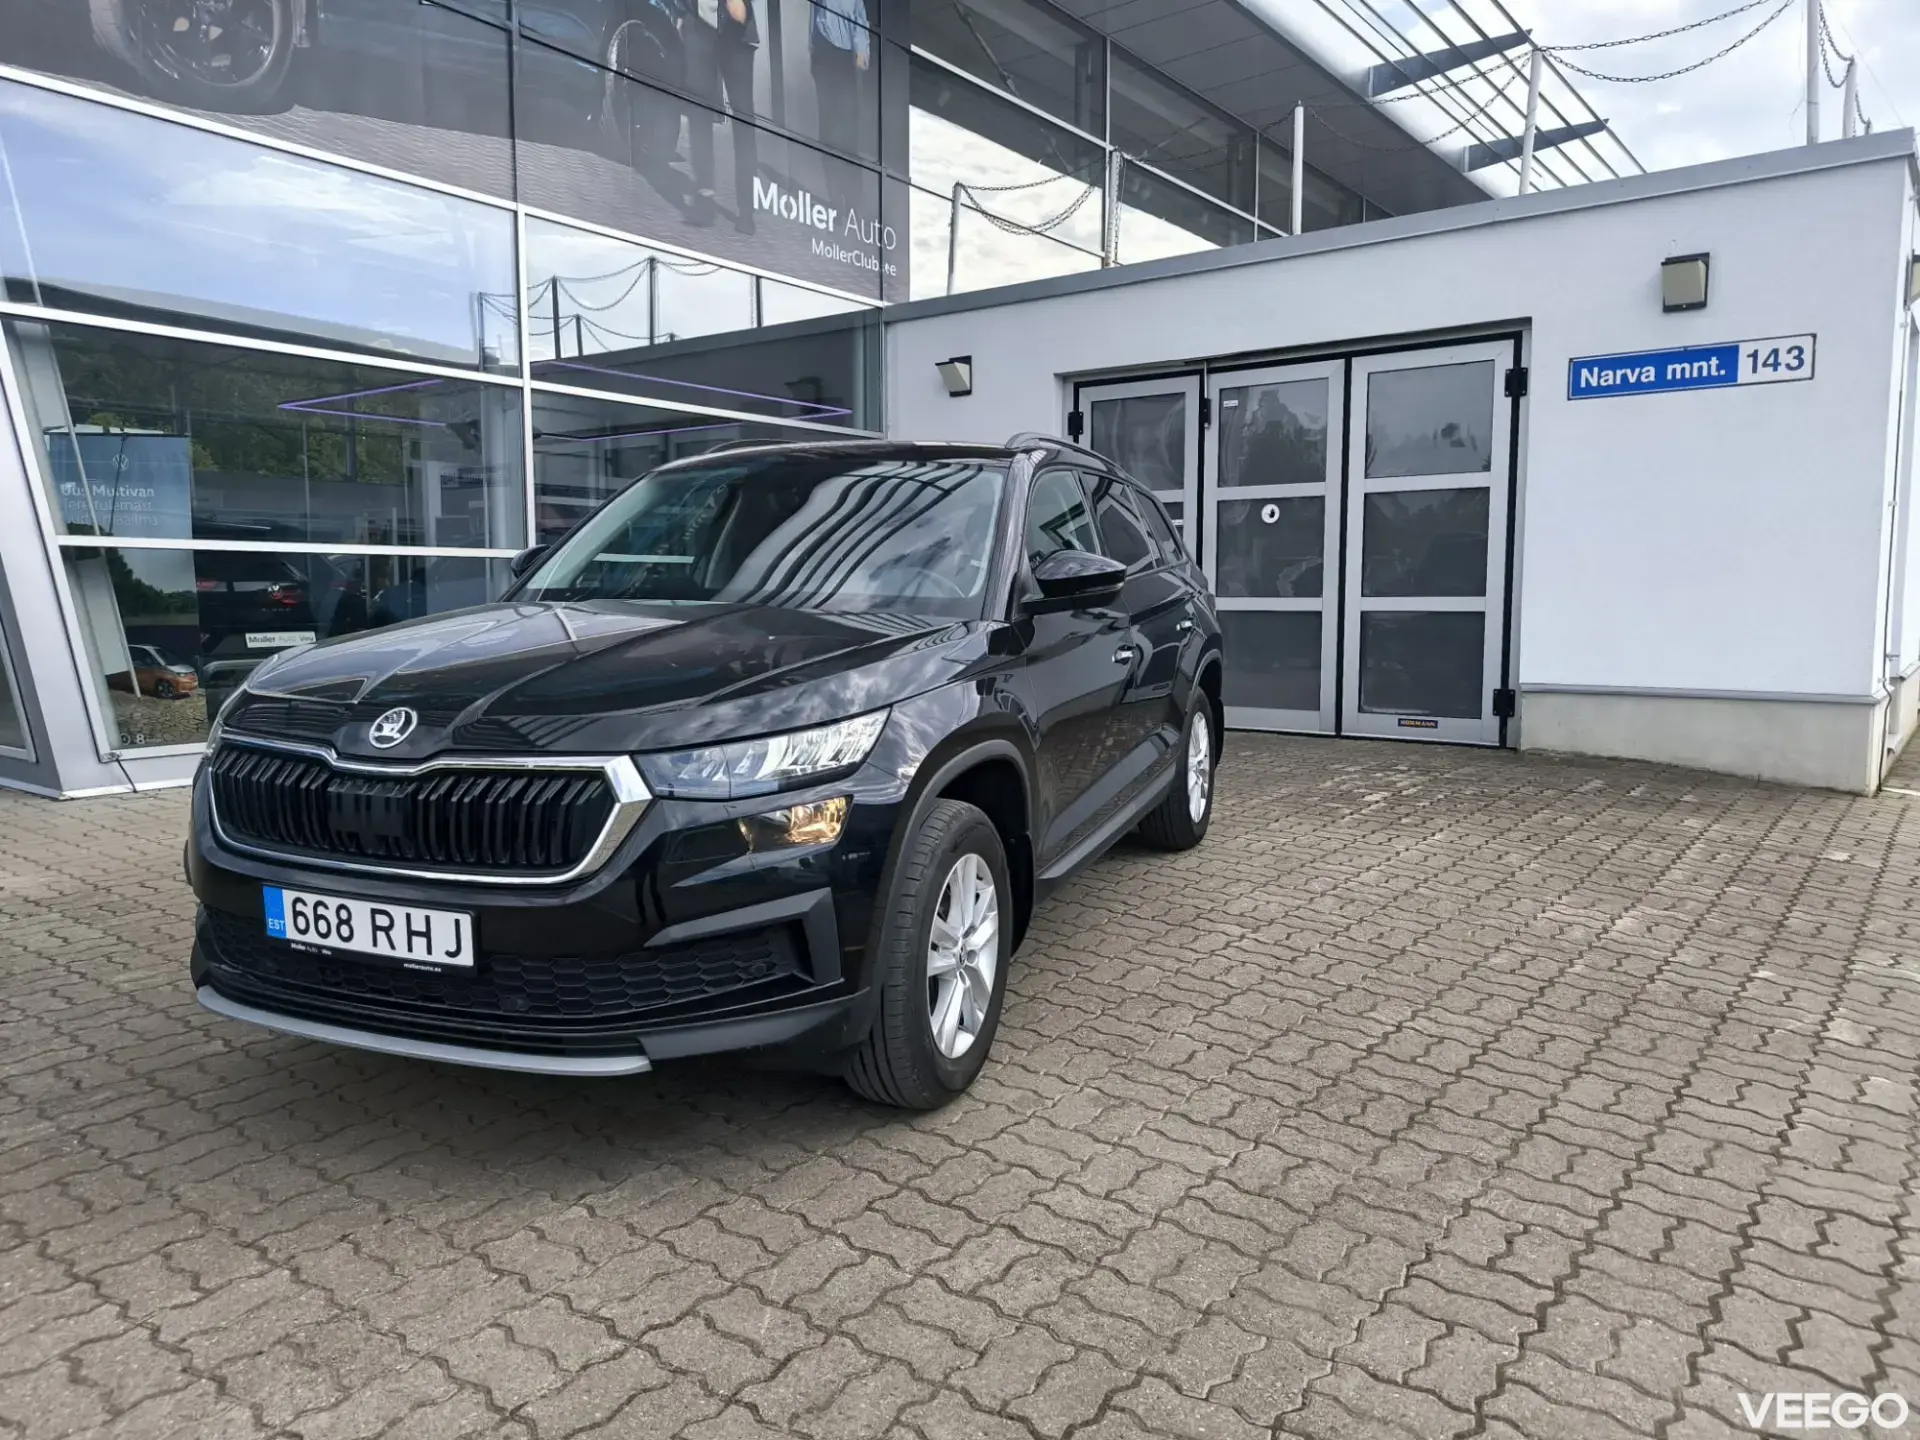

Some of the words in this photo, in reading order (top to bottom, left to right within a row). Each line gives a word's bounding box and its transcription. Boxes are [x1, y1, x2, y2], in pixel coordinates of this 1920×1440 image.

[844, 208, 896, 250] Auto
[1579, 365, 1656, 388] Narva
[1666, 356, 1726, 380] mnt.
[1746, 345, 1806, 374] 143
[268, 918, 286, 931] EST
[291, 897, 355, 943] 668
[370, 907, 463, 958] RHJ
